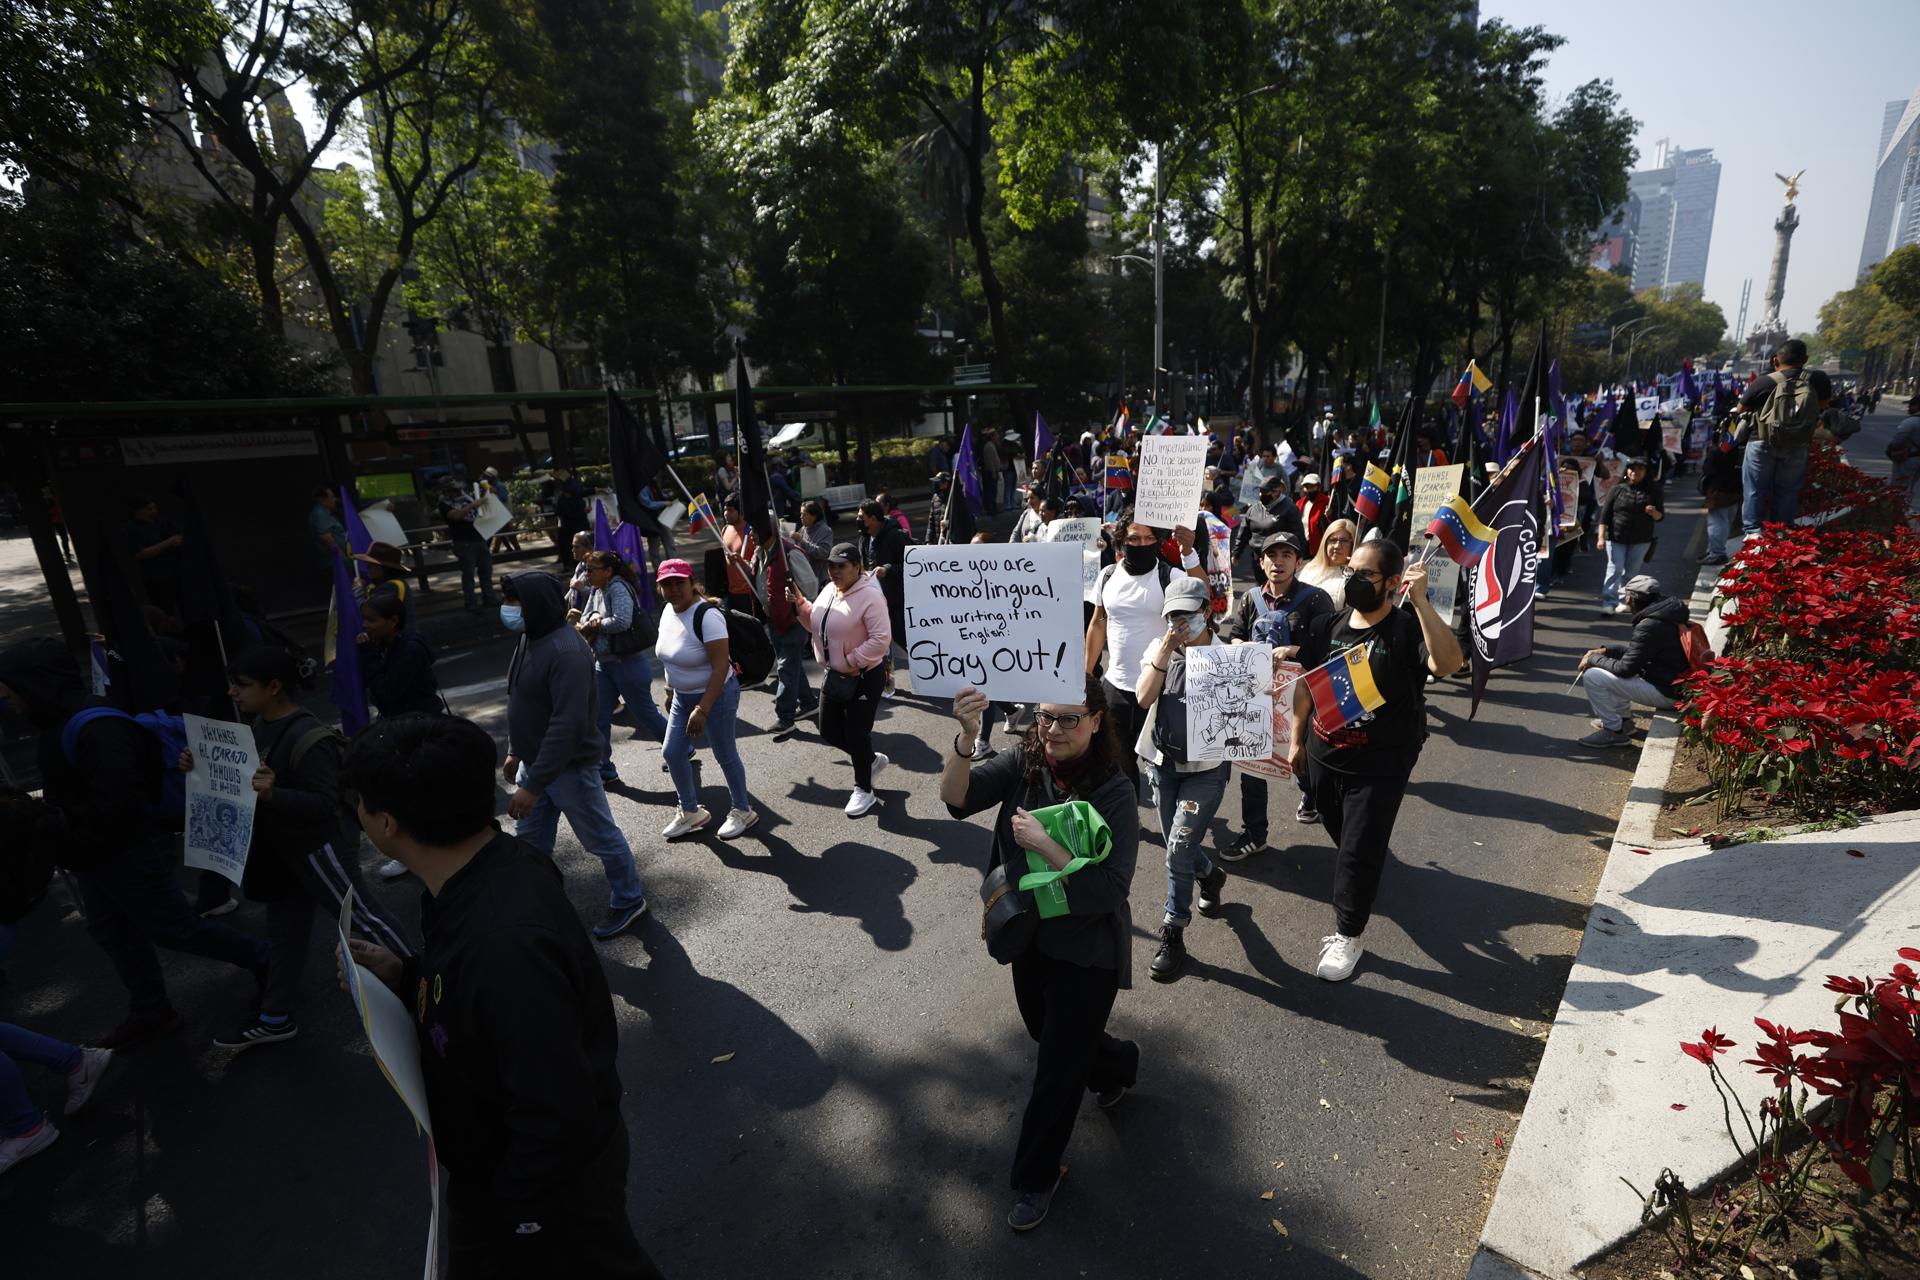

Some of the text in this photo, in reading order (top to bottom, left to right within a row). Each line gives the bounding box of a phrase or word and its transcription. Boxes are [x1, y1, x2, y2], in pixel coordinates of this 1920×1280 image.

[1143, 455, 1158, 466] NO
[1139, 501, 1153, 509] con
[1519, 523, 1537, 584] CCION
[905, 548, 1036, 586] Since you are
[906, 606, 1042, 630] I am writing it in
[910, 640, 987, 685] Stay
[199, 743, 248, 764] AL CARAJO
[208, 762, 241, 784] YANQUIS
